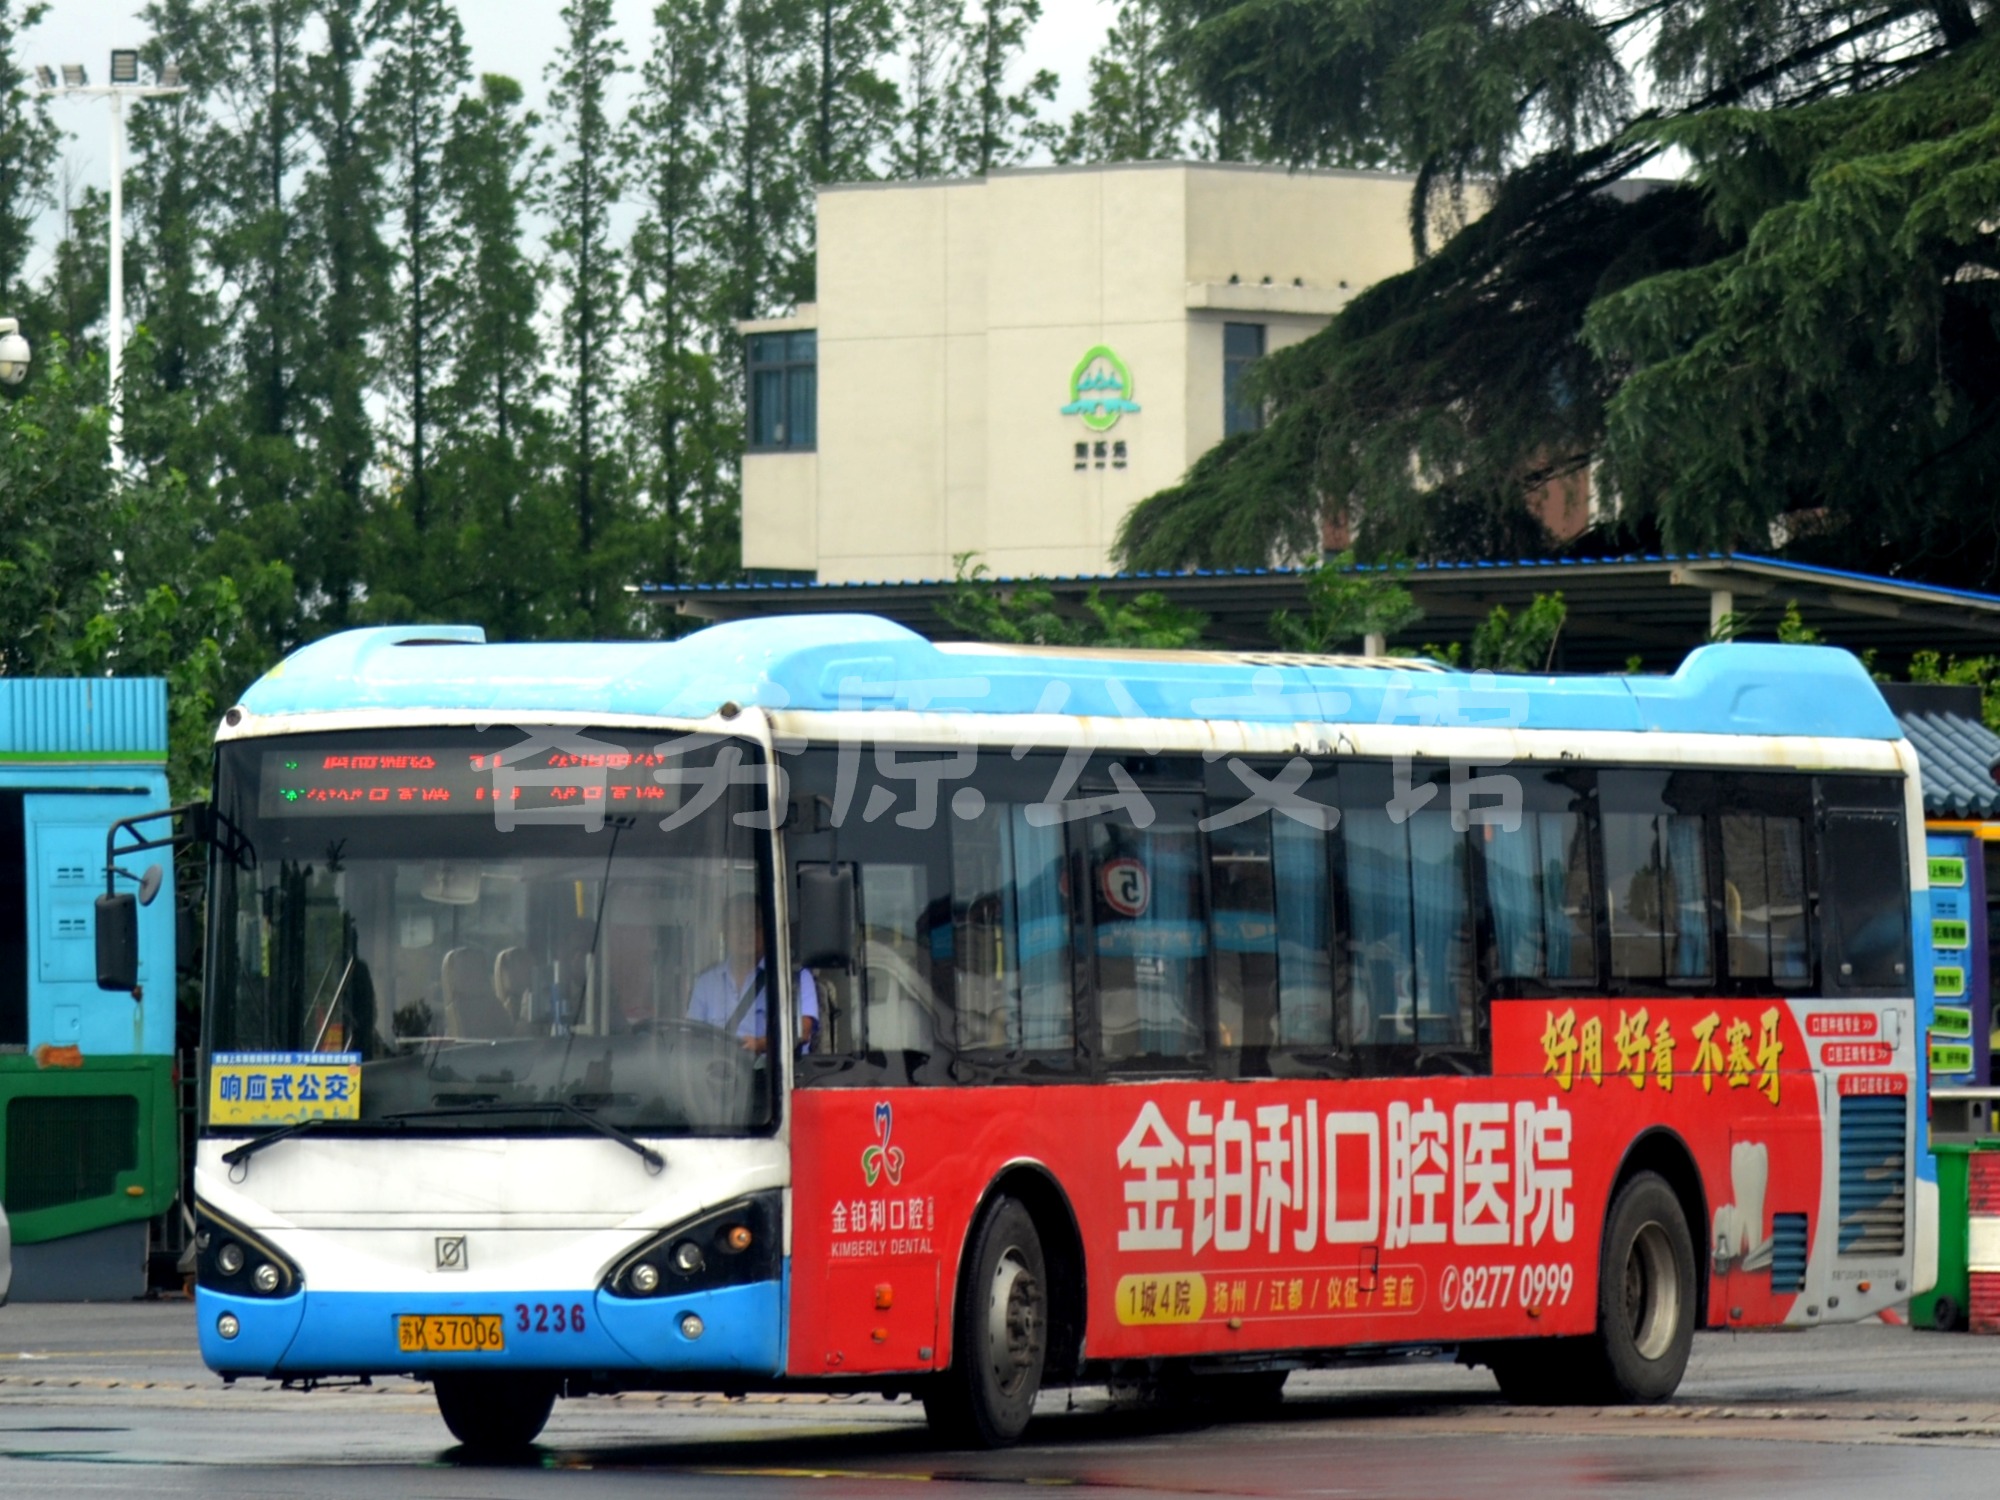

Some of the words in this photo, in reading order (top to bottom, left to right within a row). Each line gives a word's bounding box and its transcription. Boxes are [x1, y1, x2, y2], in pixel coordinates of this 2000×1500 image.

[1540, 1007, 1602, 1092] 好用
[1614, 1006, 1676, 1092] 好看
[1691, 1007, 1783, 1105] 不塞牙
[220, 1074, 348, 1101] 响应式公交
[1116, 1096, 1574, 1256] 金铂利口腔医院
[832, 1197, 923, 1233] 金铂利口腔
[832, 1239, 886, 1257] KIMBERLY
[891, 1238, 933, 1255] DENTAL
[1130, 1280, 1190, 1317] 1城4院
[1214, 1280, 1246, 1314] 扬州
[1270, 1278, 1303, 1311] 江都
[1328, 1276, 1359, 1309] 仪征
[1382, 1275, 1414, 1307] 宝应
[1461, 1265, 1516, 1310] 8277
[1519, 1263, 1573, 1308] 0999
[515, 1303, 585, 1333] 3236
